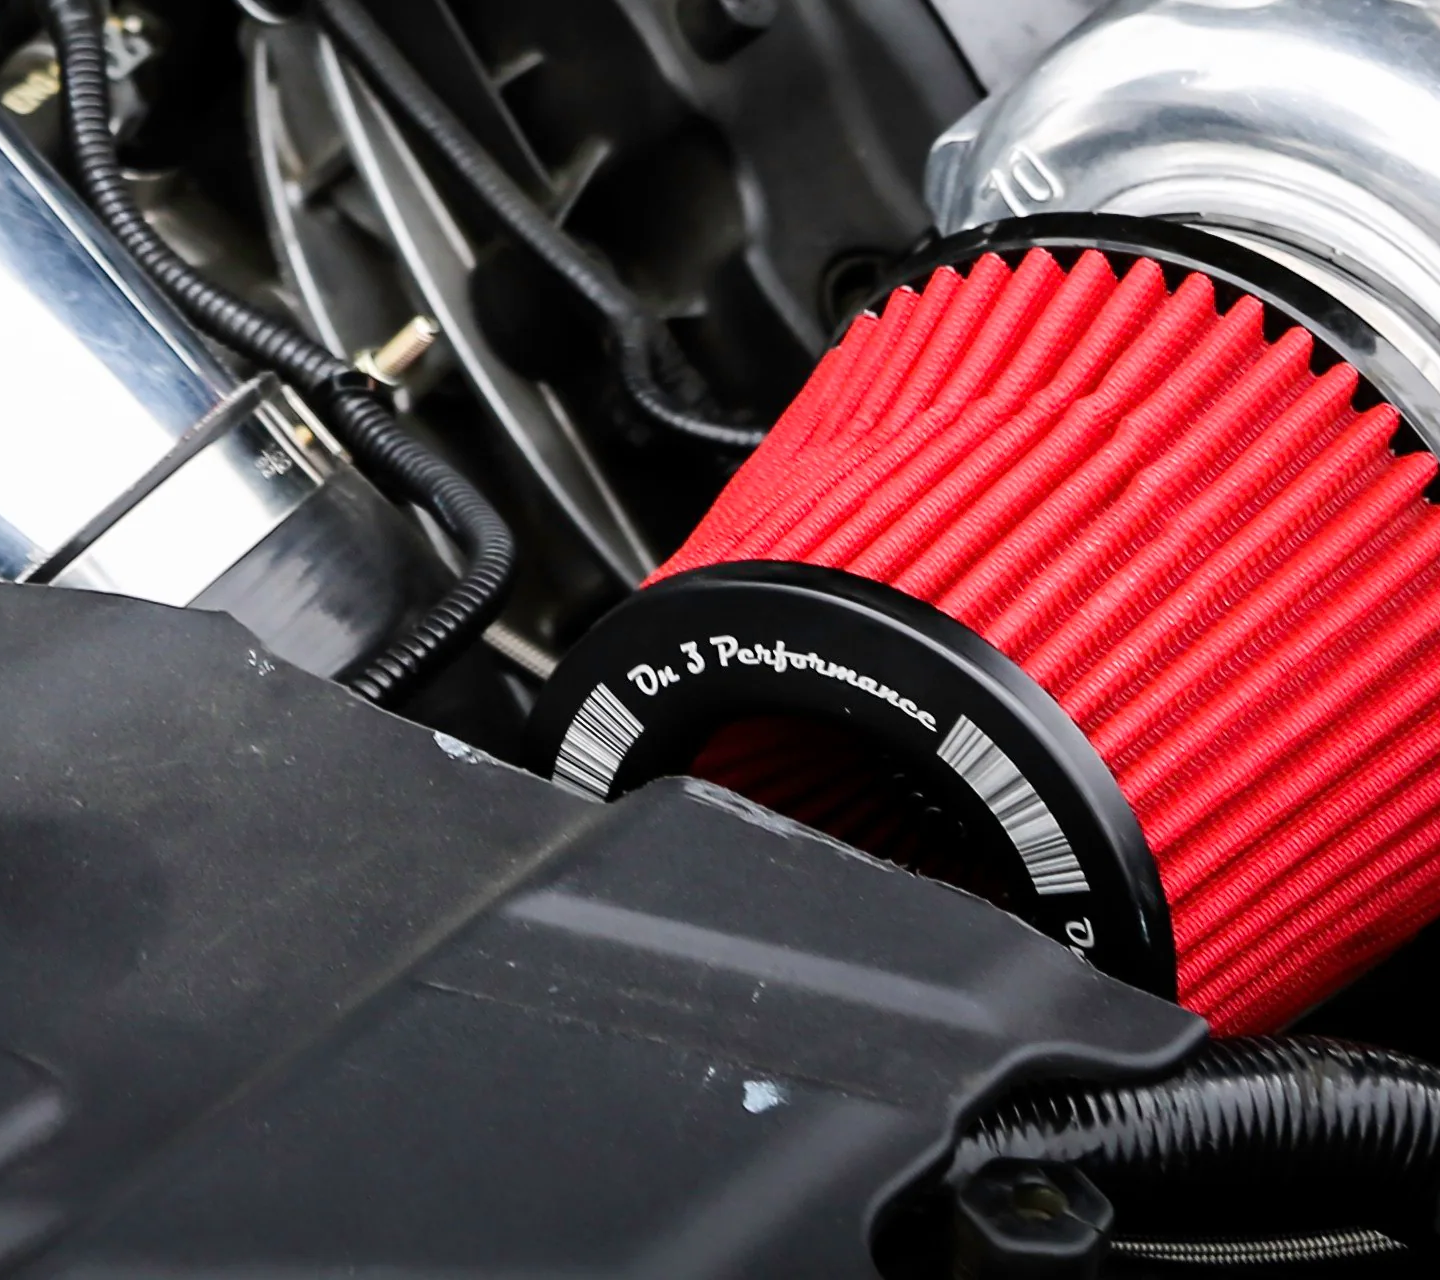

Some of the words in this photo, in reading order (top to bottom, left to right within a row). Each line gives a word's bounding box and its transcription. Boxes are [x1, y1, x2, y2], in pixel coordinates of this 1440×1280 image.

[627, 663, 680, 696] On
[680, 641, 706, 675] 3
[709, 635, 938, 732] Performance
